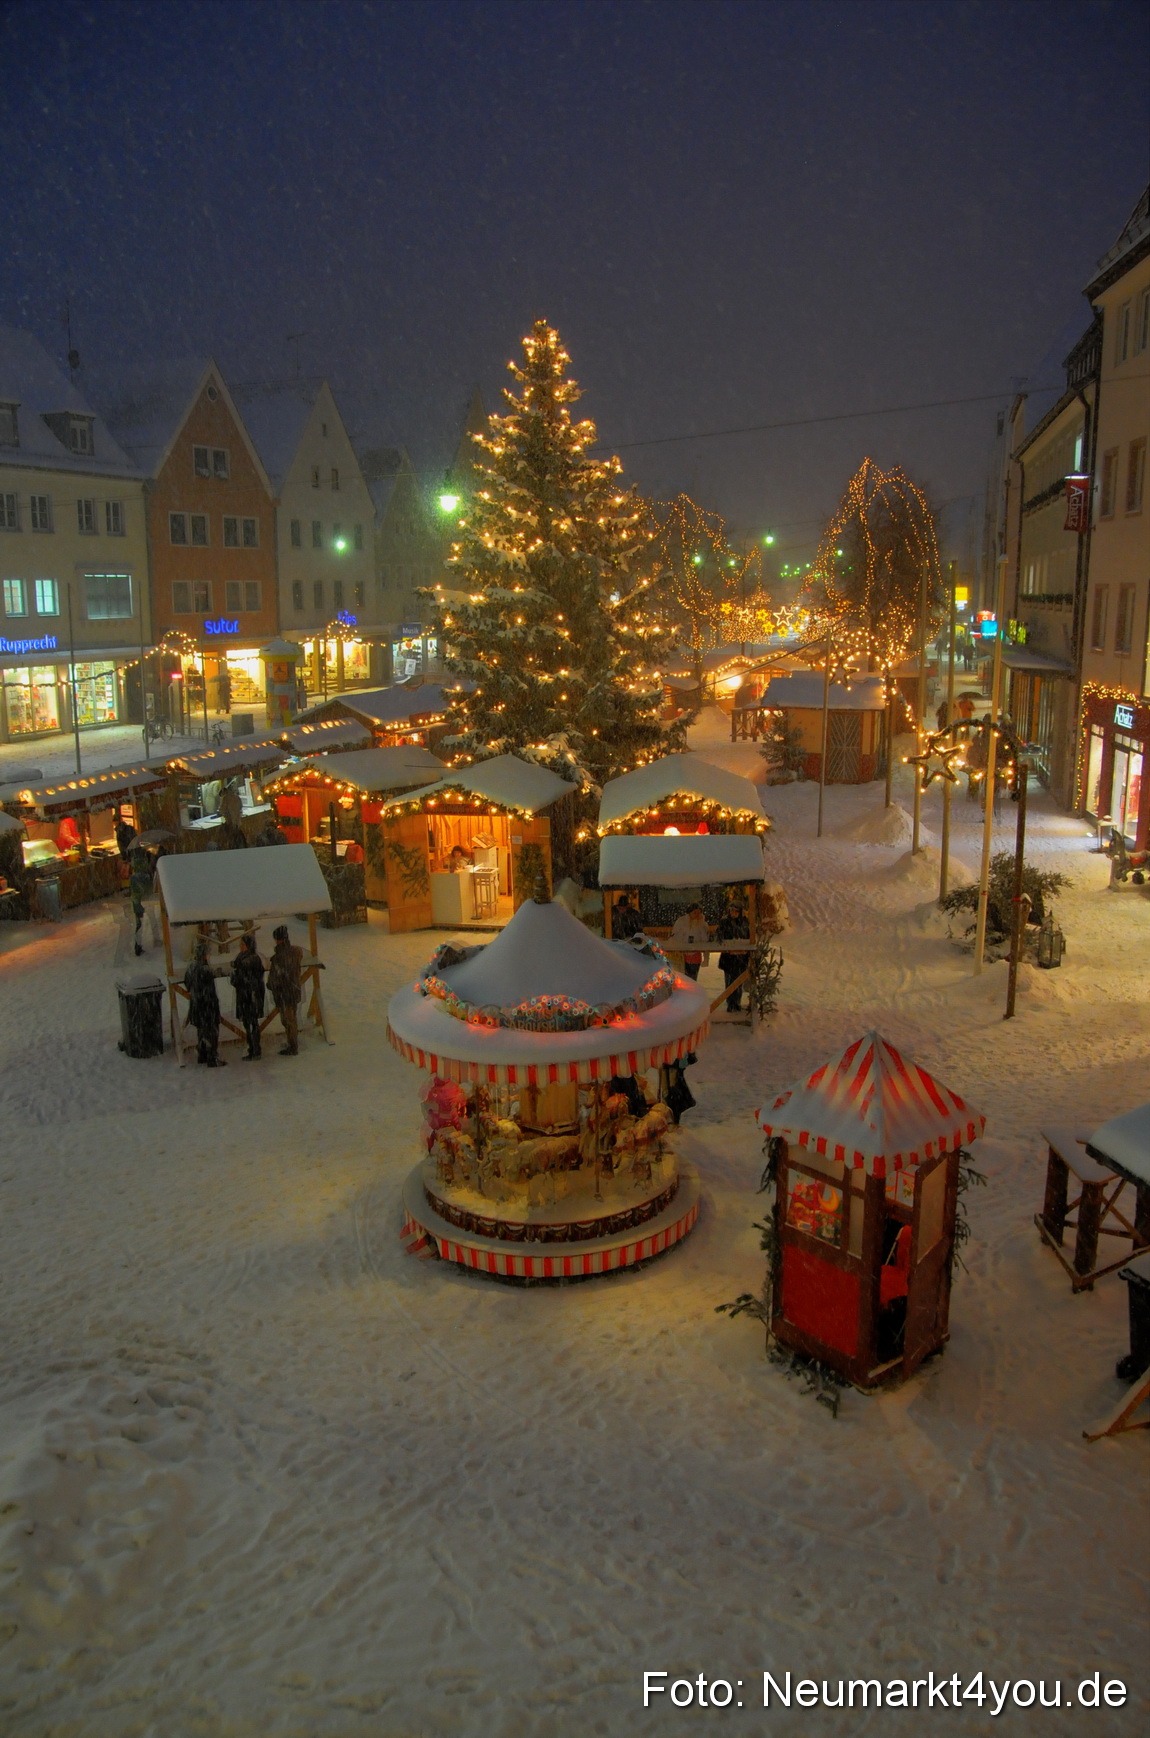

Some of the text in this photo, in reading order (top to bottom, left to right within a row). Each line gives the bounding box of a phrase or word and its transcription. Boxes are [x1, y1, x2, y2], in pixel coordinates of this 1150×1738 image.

[1069, 485, 1084, 527] Achatz
[0, 634, 58, 655] Rupprecht
[1113, 704, 1133, 729] Achatz
